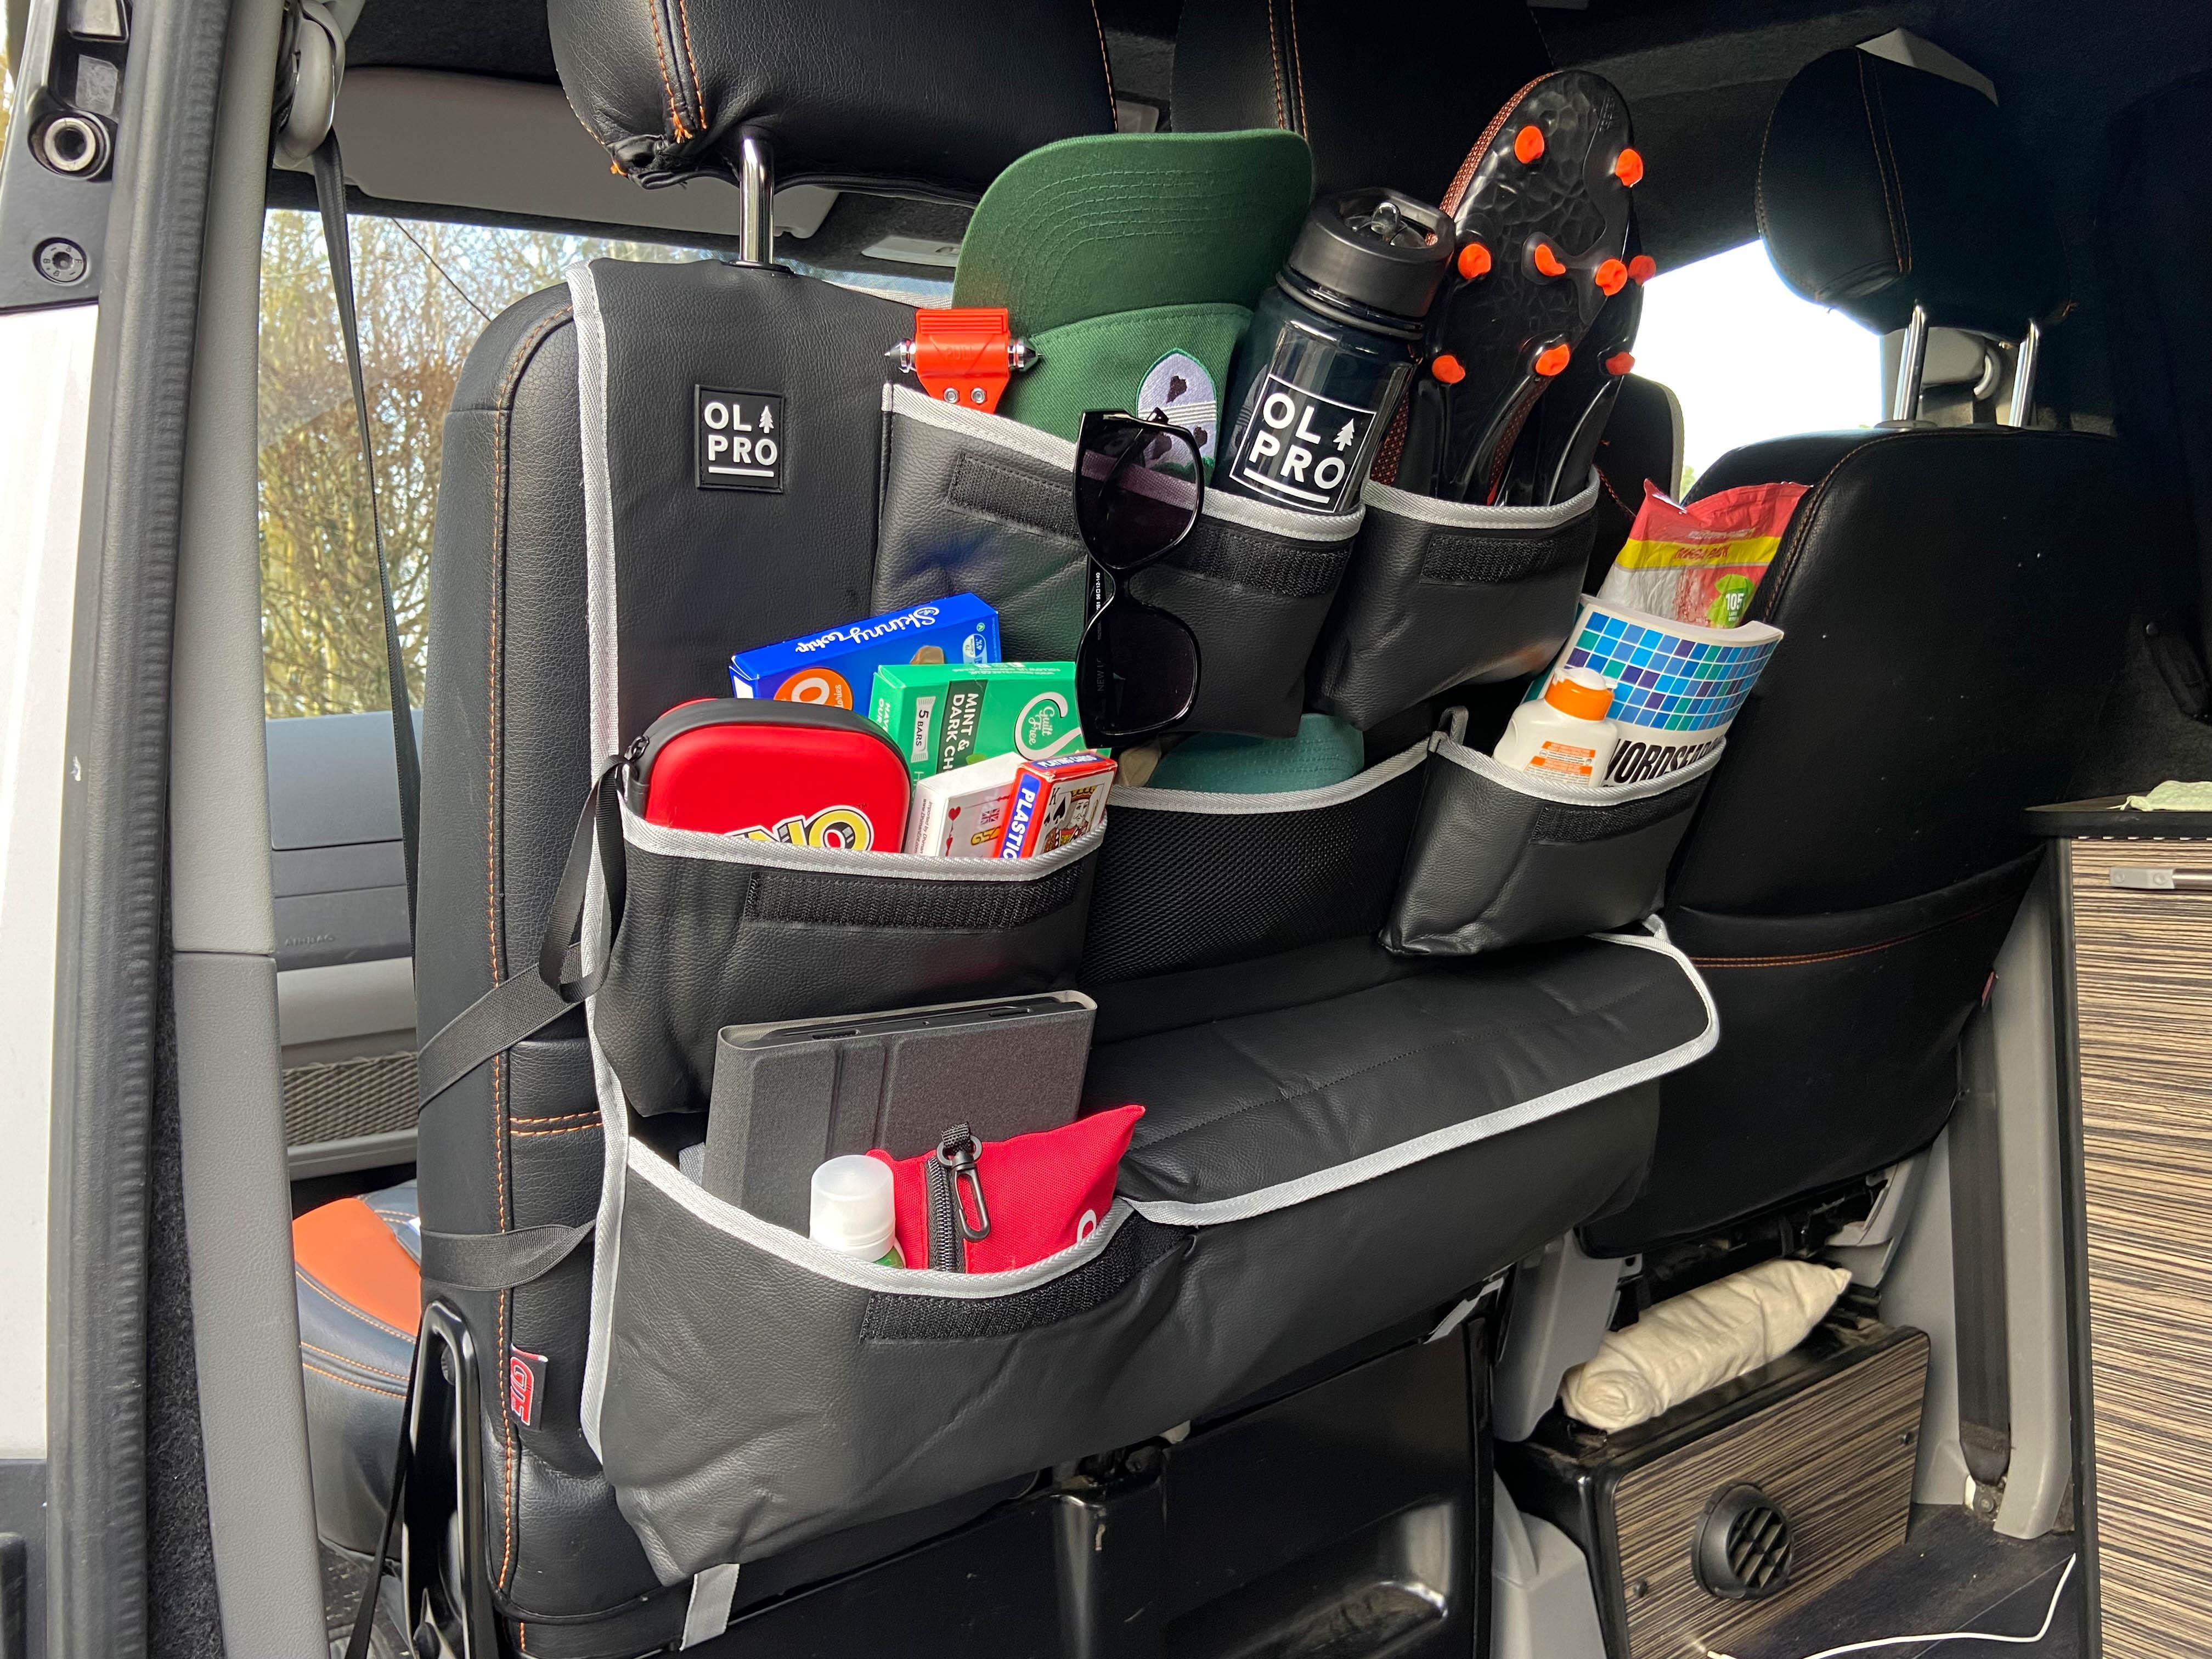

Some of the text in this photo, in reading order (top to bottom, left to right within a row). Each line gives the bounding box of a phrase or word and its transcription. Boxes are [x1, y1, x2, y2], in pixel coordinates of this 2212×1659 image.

[704, 402, 752, 431] OL
[1263, 393, 1321, 444] OL
[708, 435, 777, 465] PRO
[1249, 430, 1345, 489] PRO
[1725, 593, 1744, 611] 105
[849, 607, 940, 644] Skinny
[916, 709, 929, 747] 5 BARS
[946, 694, 966, 742] DARK
[957, 693, 979, 752] MINT &
[1029, 714, 1042, 746] Free
[1039, 706, 1055, 736] Guilt
[1037, 757, 1074, 768] PLAYING
[1049, 787, 1060, 806] K
[1003, 788, 1036, 859] PLASTIC
